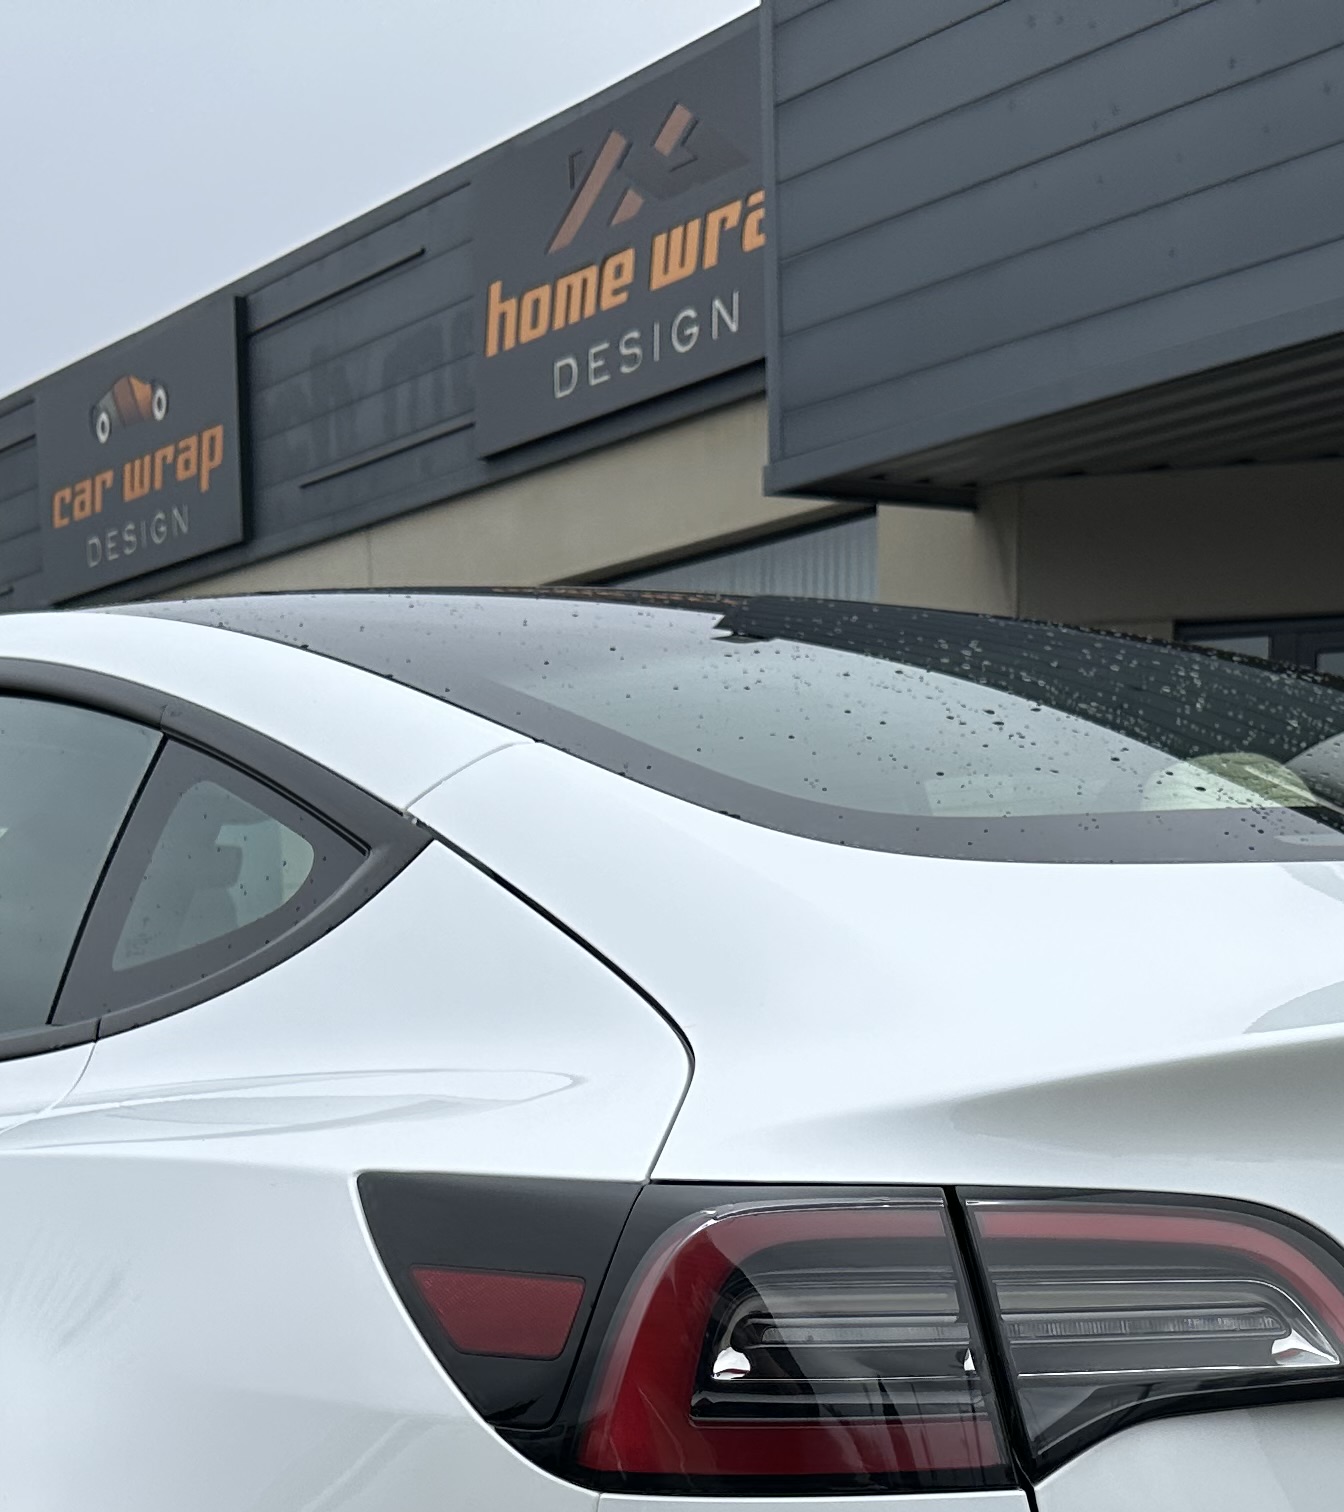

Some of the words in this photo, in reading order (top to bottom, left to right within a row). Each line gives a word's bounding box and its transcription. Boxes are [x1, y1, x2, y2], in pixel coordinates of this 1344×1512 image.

[484, 247, 636, 358] home
[553, 289, 740, 399] DESIGN
[51, 469, 115, 529] car
[122, 424, 224, 503] wrap
[86, 503, 189, 568] DESIGN
